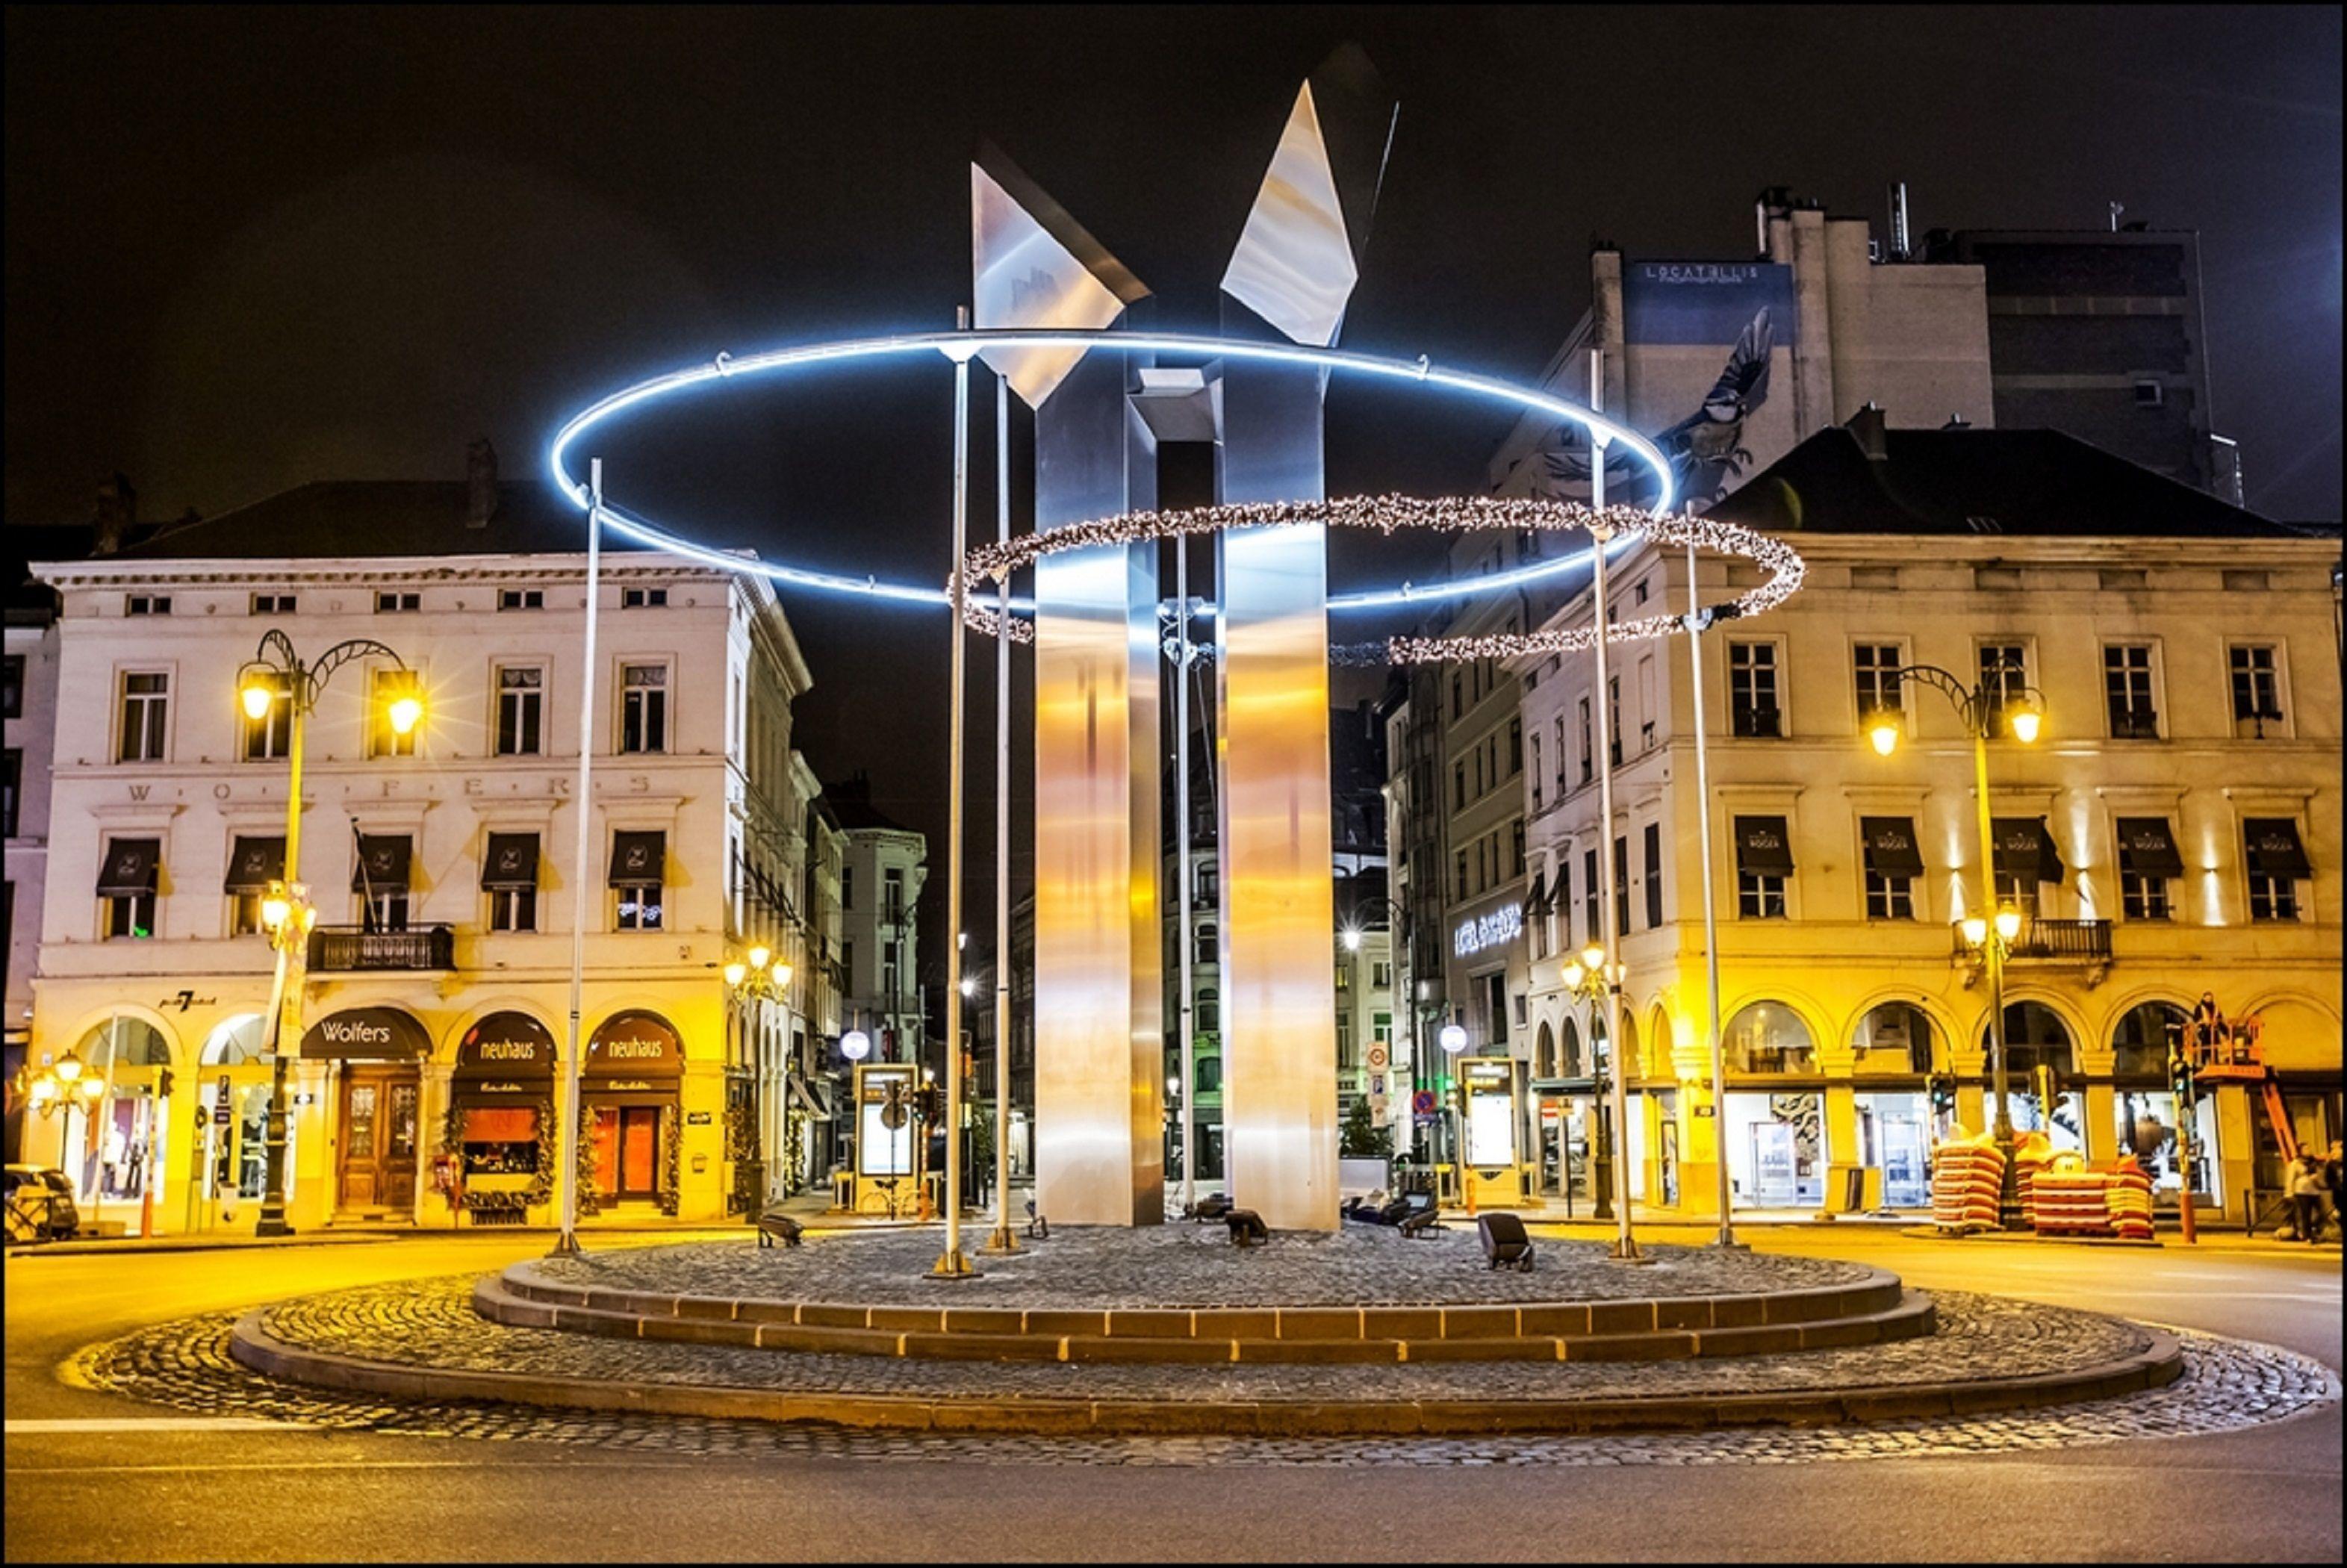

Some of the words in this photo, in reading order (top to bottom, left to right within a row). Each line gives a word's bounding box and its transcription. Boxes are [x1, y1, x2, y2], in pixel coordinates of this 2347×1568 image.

[321, 1020, 391, 1044] Wolfers
[480, 1037, 536, 1060] neuhaus
[608, 1036, 664, 1059] neuhaus
